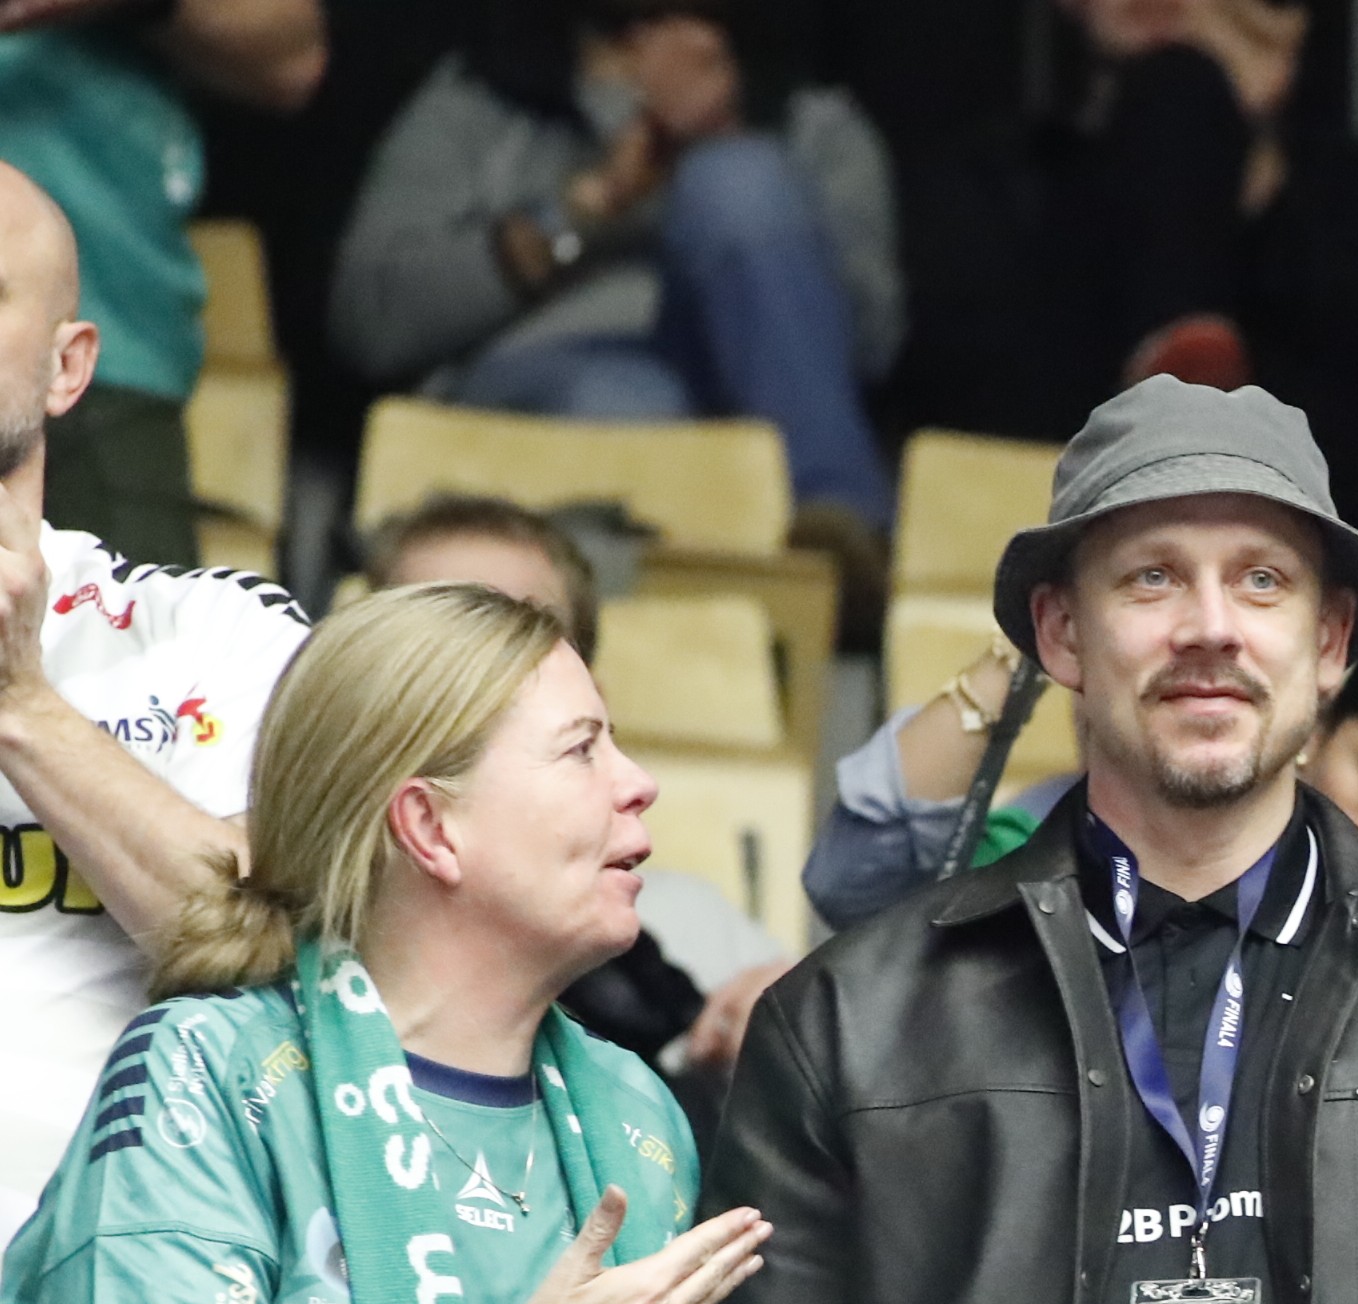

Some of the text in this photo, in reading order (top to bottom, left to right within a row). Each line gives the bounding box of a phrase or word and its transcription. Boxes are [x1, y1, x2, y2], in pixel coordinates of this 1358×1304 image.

[91, 716, 153, 742] MS
[1216, 998, 1242, 1049] FINAL4
[455, 1203, 514, 1232] SELECT
[1168, 1190, 1264, 1239] Pom
